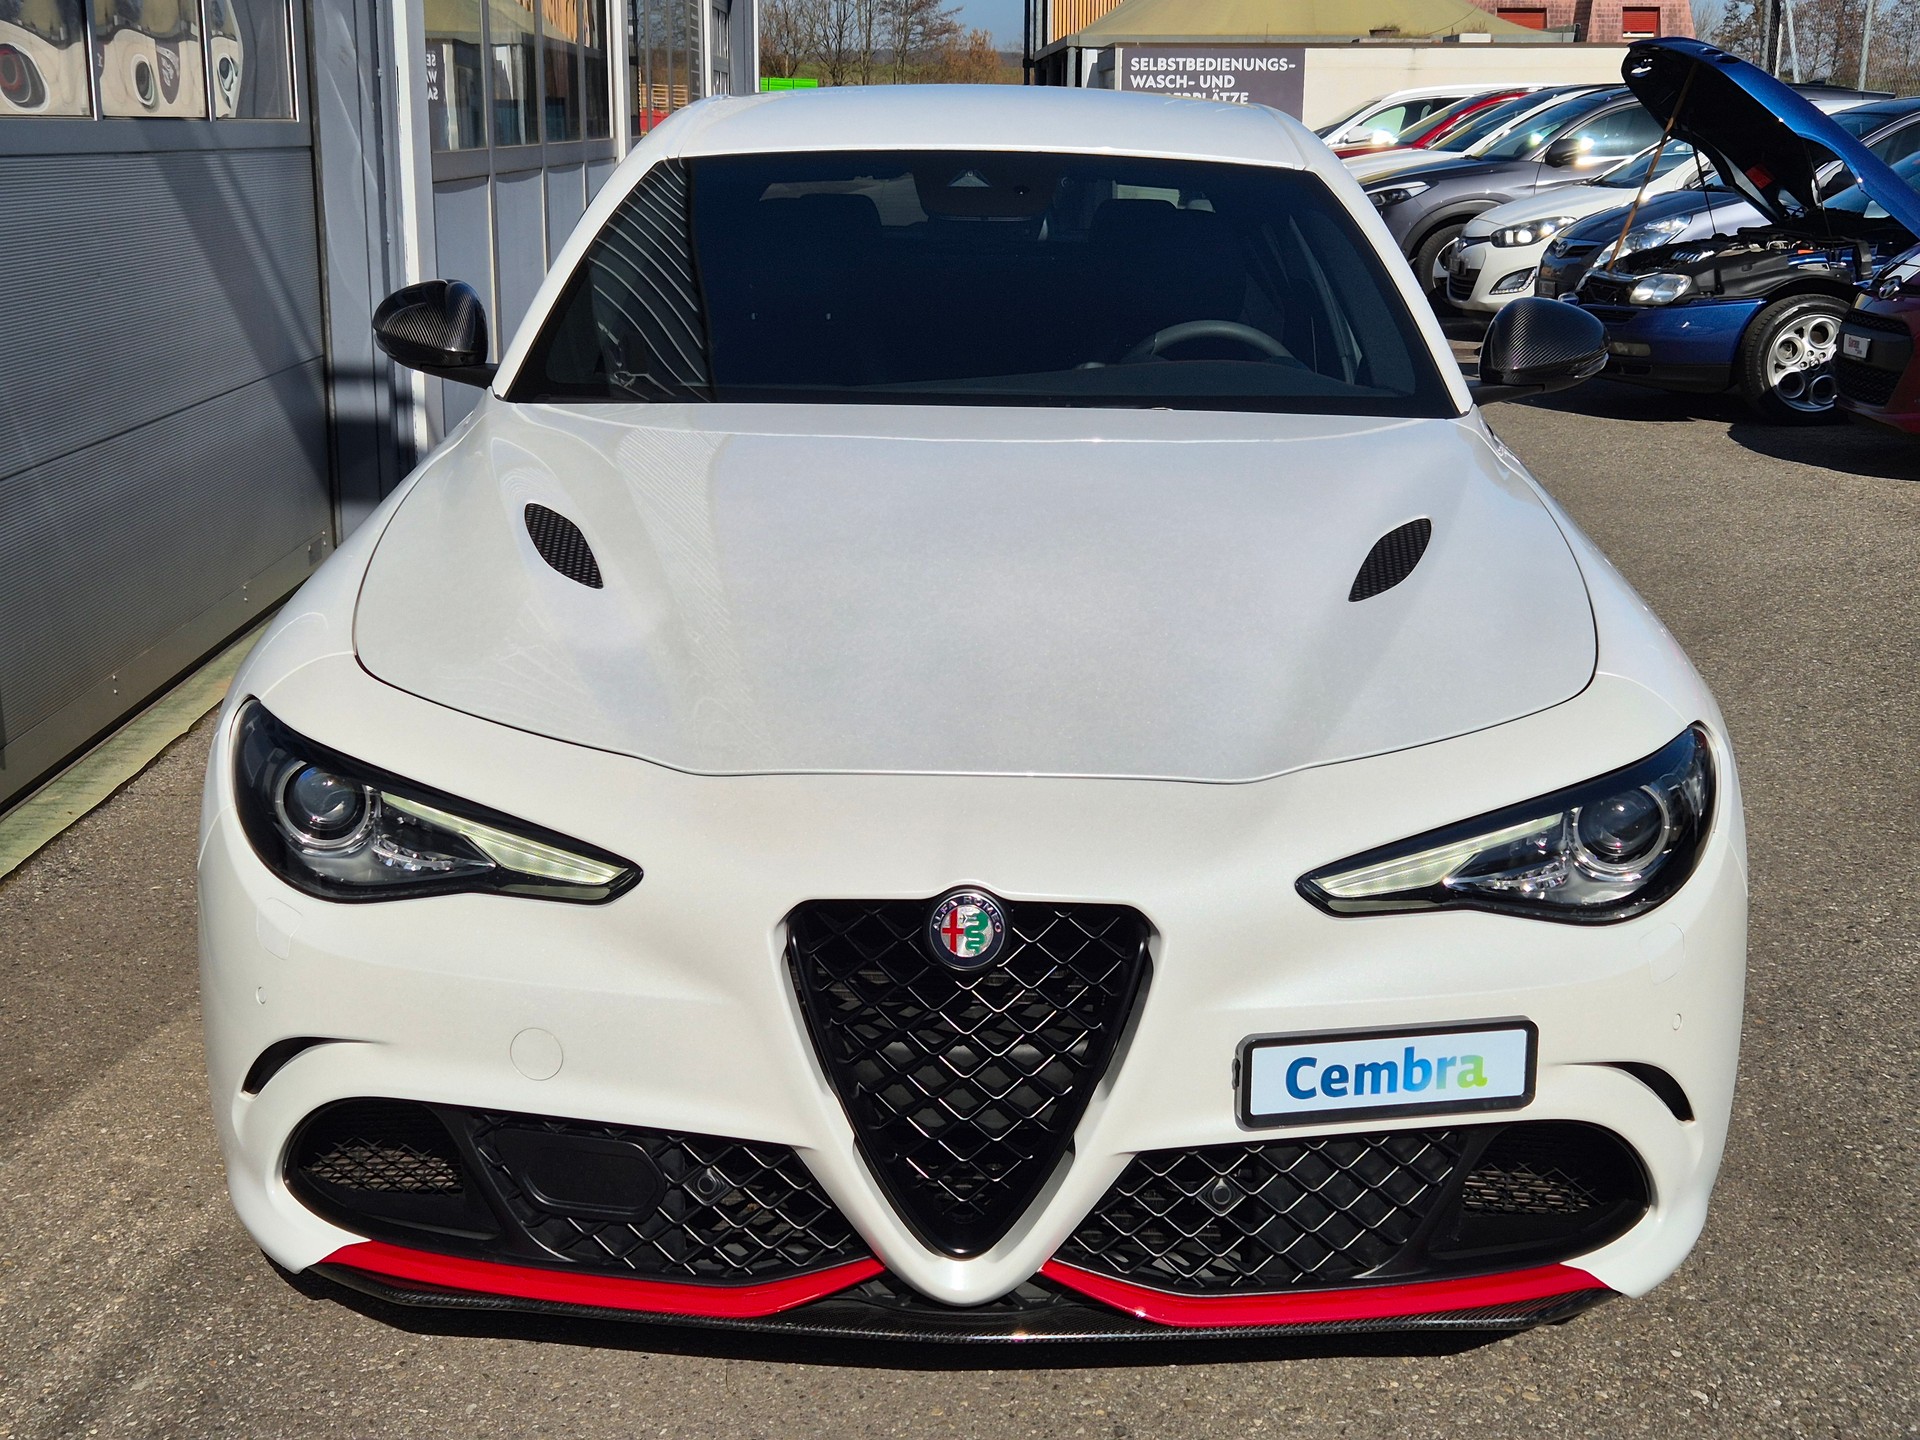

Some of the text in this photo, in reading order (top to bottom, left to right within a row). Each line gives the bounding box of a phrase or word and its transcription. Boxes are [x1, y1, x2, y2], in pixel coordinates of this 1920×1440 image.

[1130, 57, 1296, 72] SELBSTBEDIENUNGS-
[1129, 75, 1236, 89] WASCH- UND
[933, 896, 1002, 933] ALFA ROMEO
[1285, 1046, 1488, 1100] Cembra
